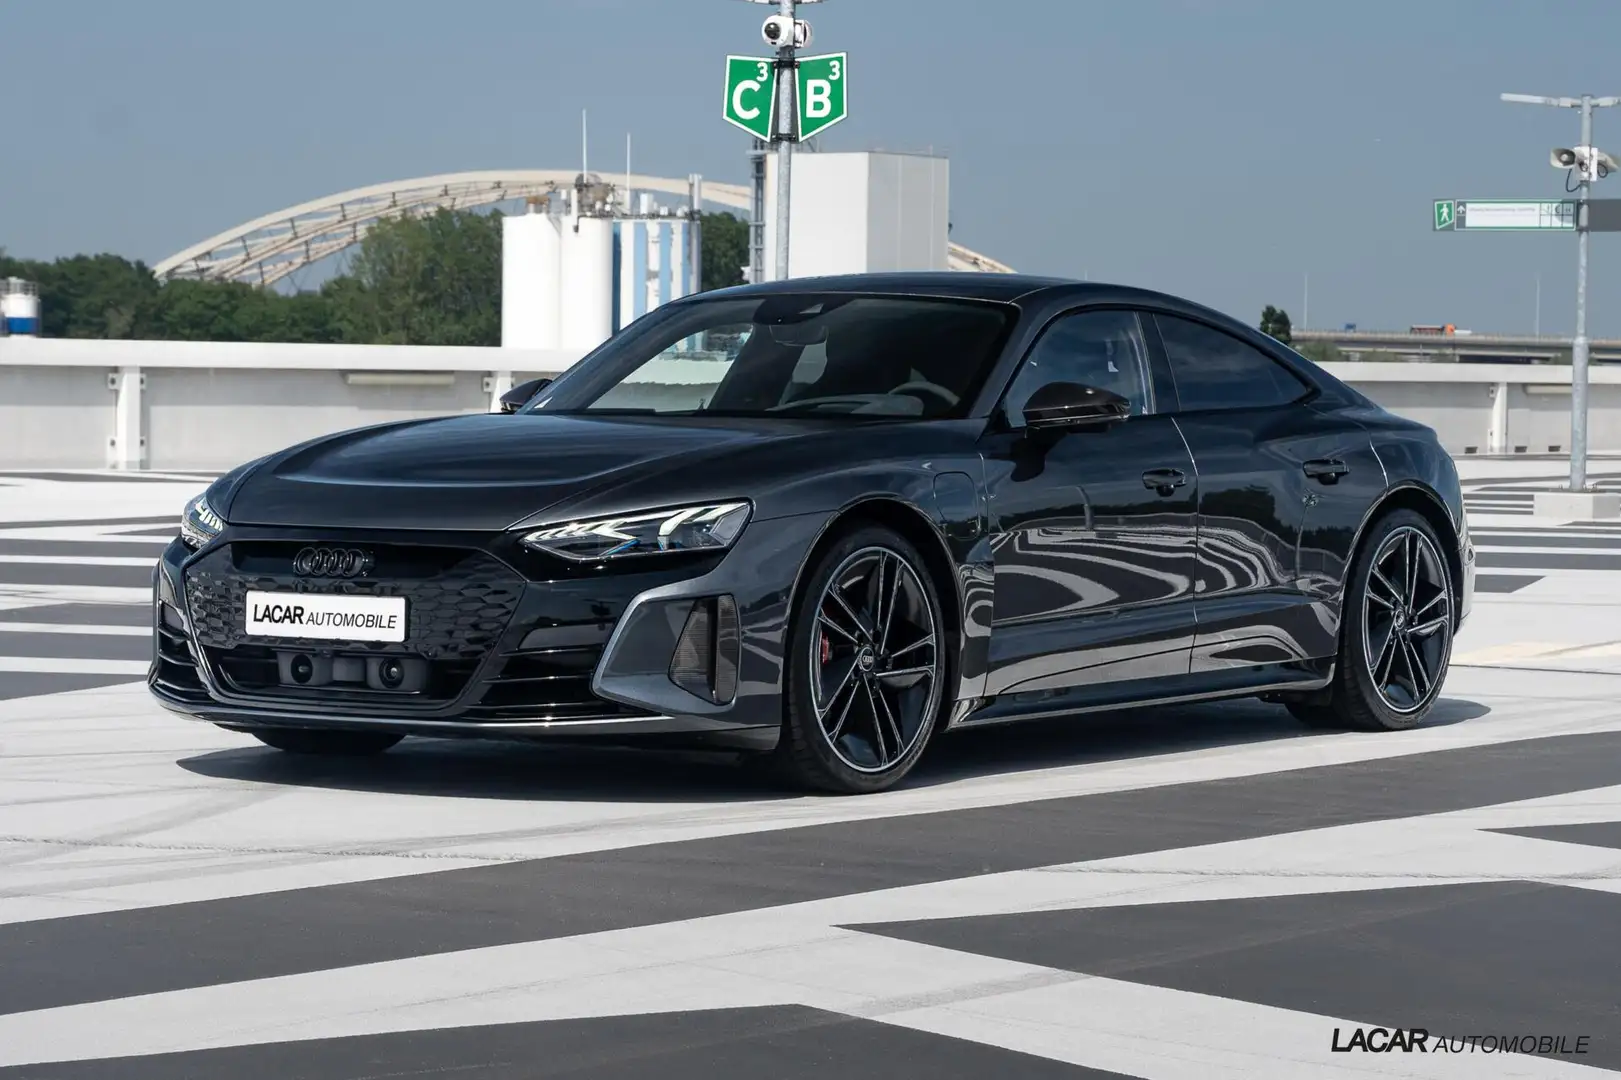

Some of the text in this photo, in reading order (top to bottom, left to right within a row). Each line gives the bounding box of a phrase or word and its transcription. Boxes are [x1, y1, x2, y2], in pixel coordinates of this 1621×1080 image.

[732, 62, 768, 120] C 3
[806, 60, 841, 118] B 3
[253, 604, 397, 629] LACAR AUTOMOBILE
